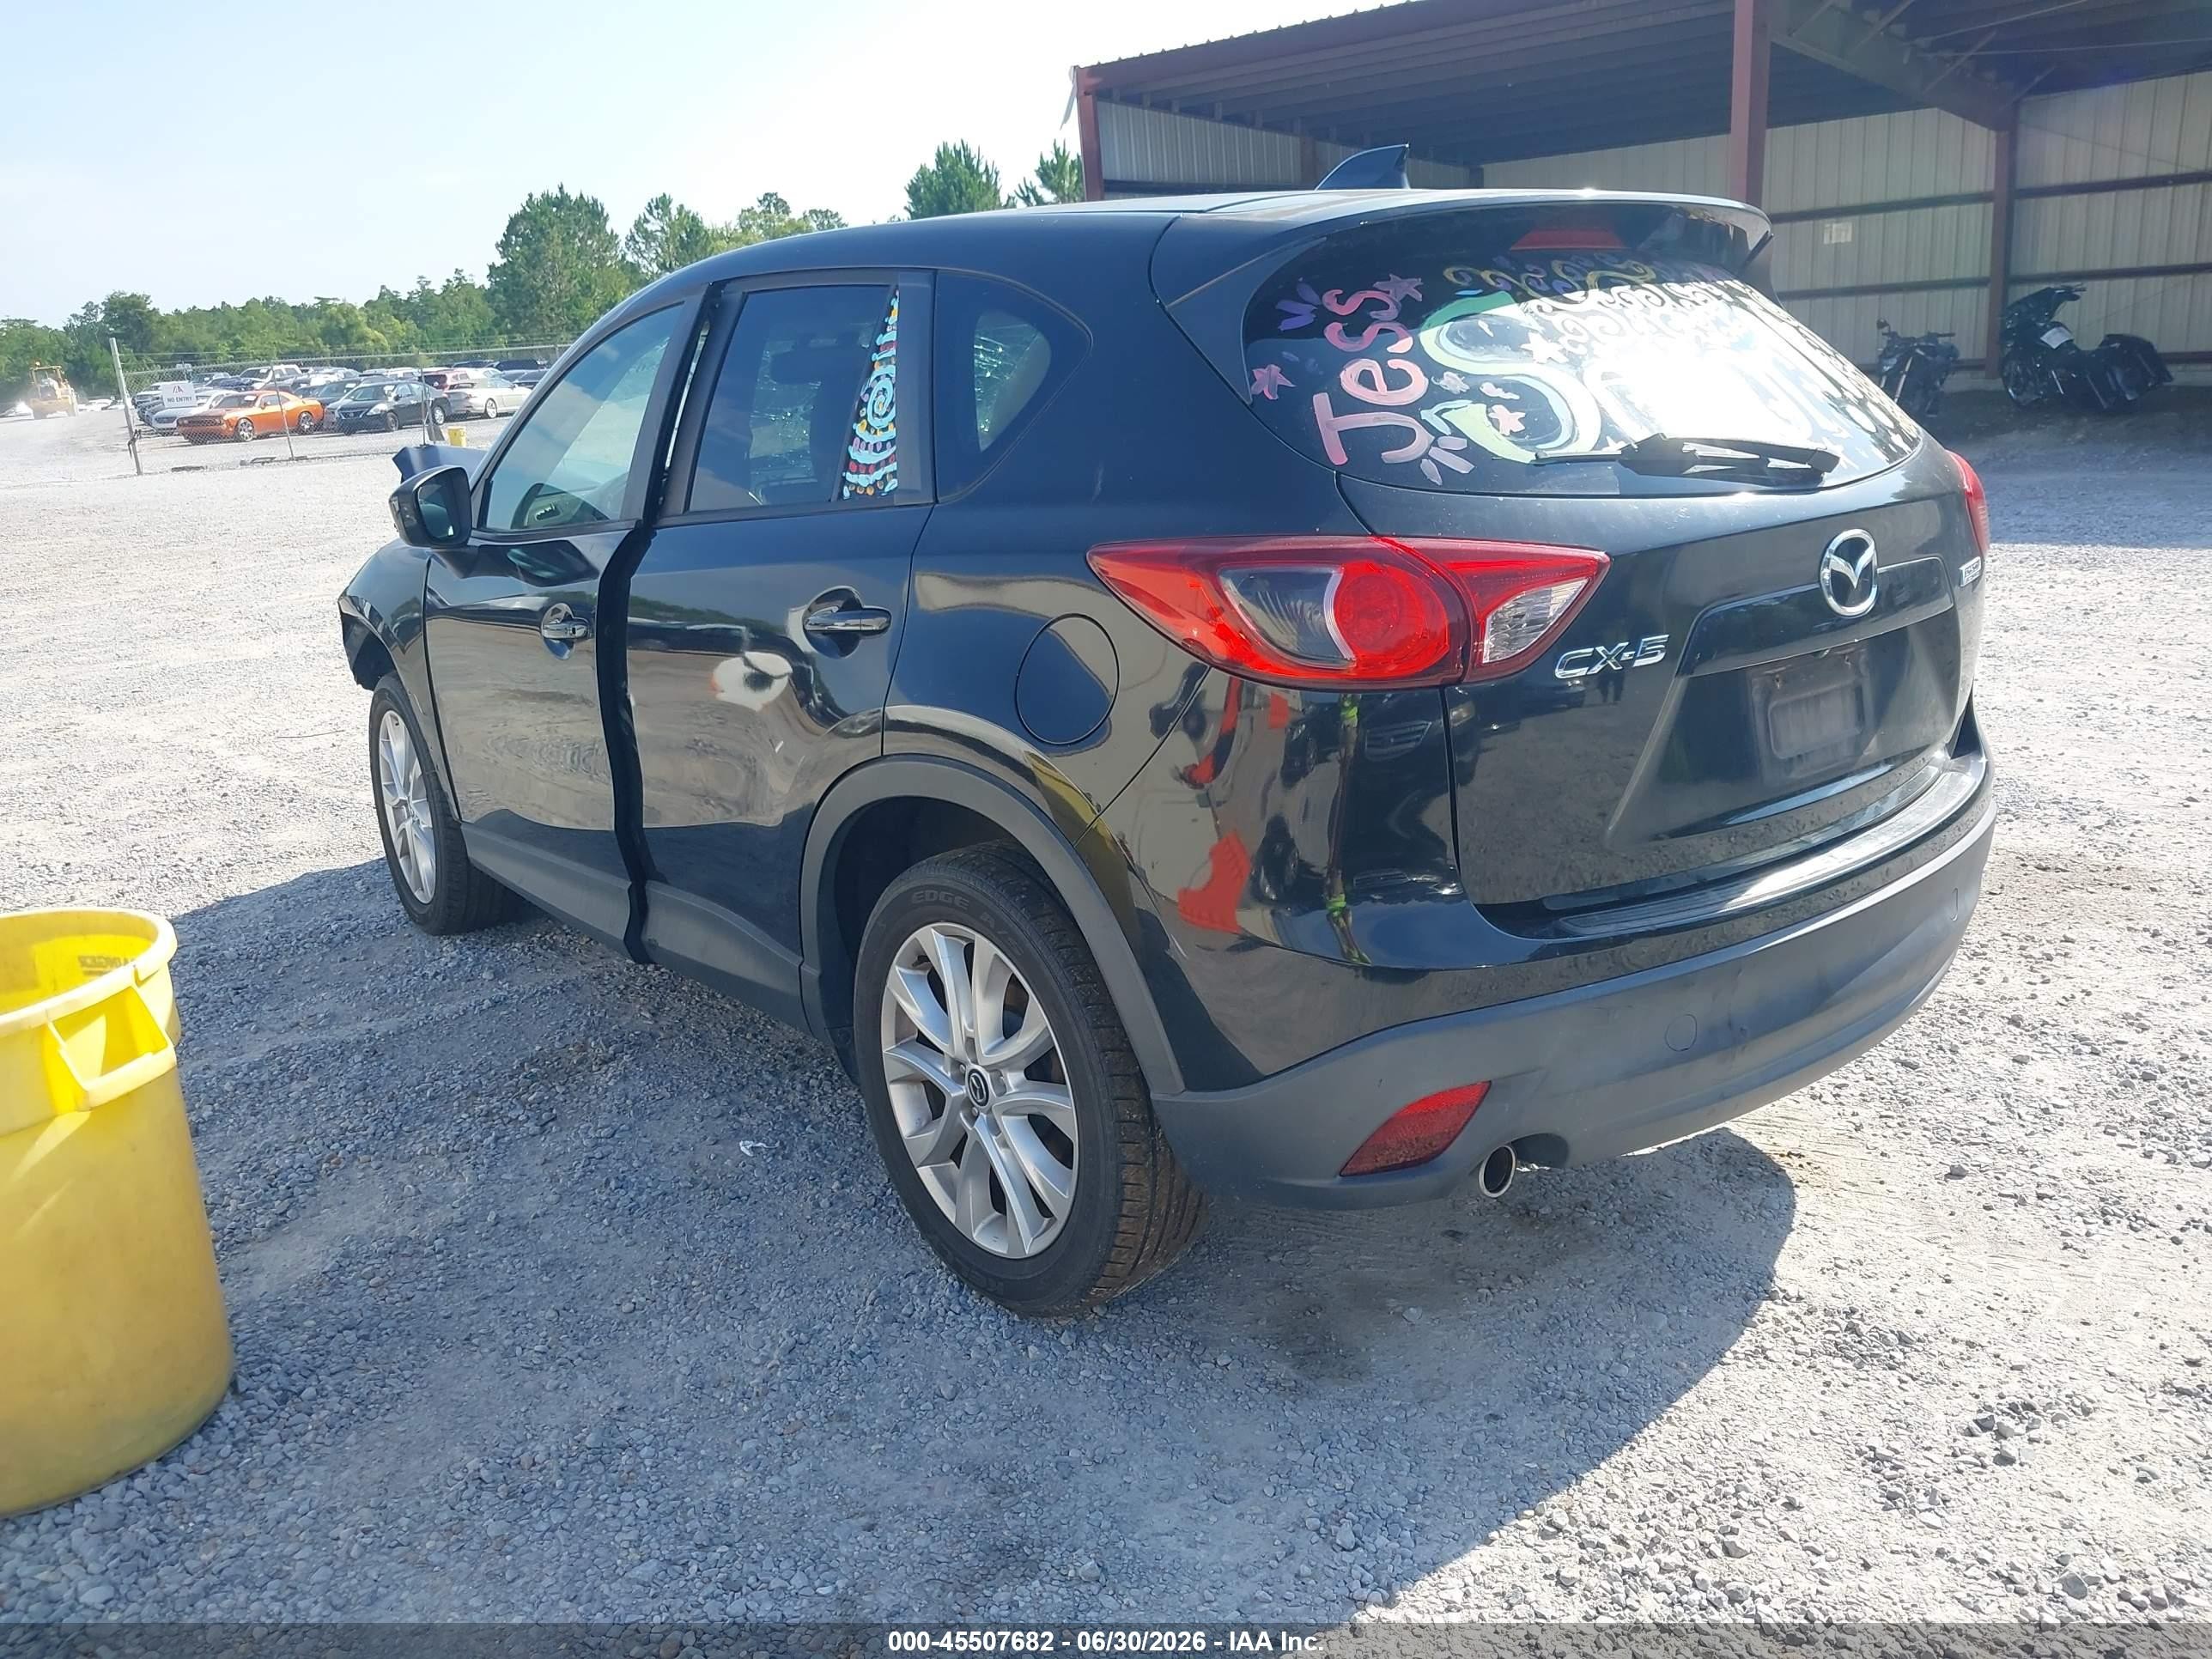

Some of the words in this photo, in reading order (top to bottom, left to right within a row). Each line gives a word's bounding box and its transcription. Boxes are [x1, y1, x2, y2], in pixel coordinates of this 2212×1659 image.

[1313, 289, 1435, 465] Jess
[1555, 635, 1670, 679] CX-5
[911, 889, 970, 910] EDGE
